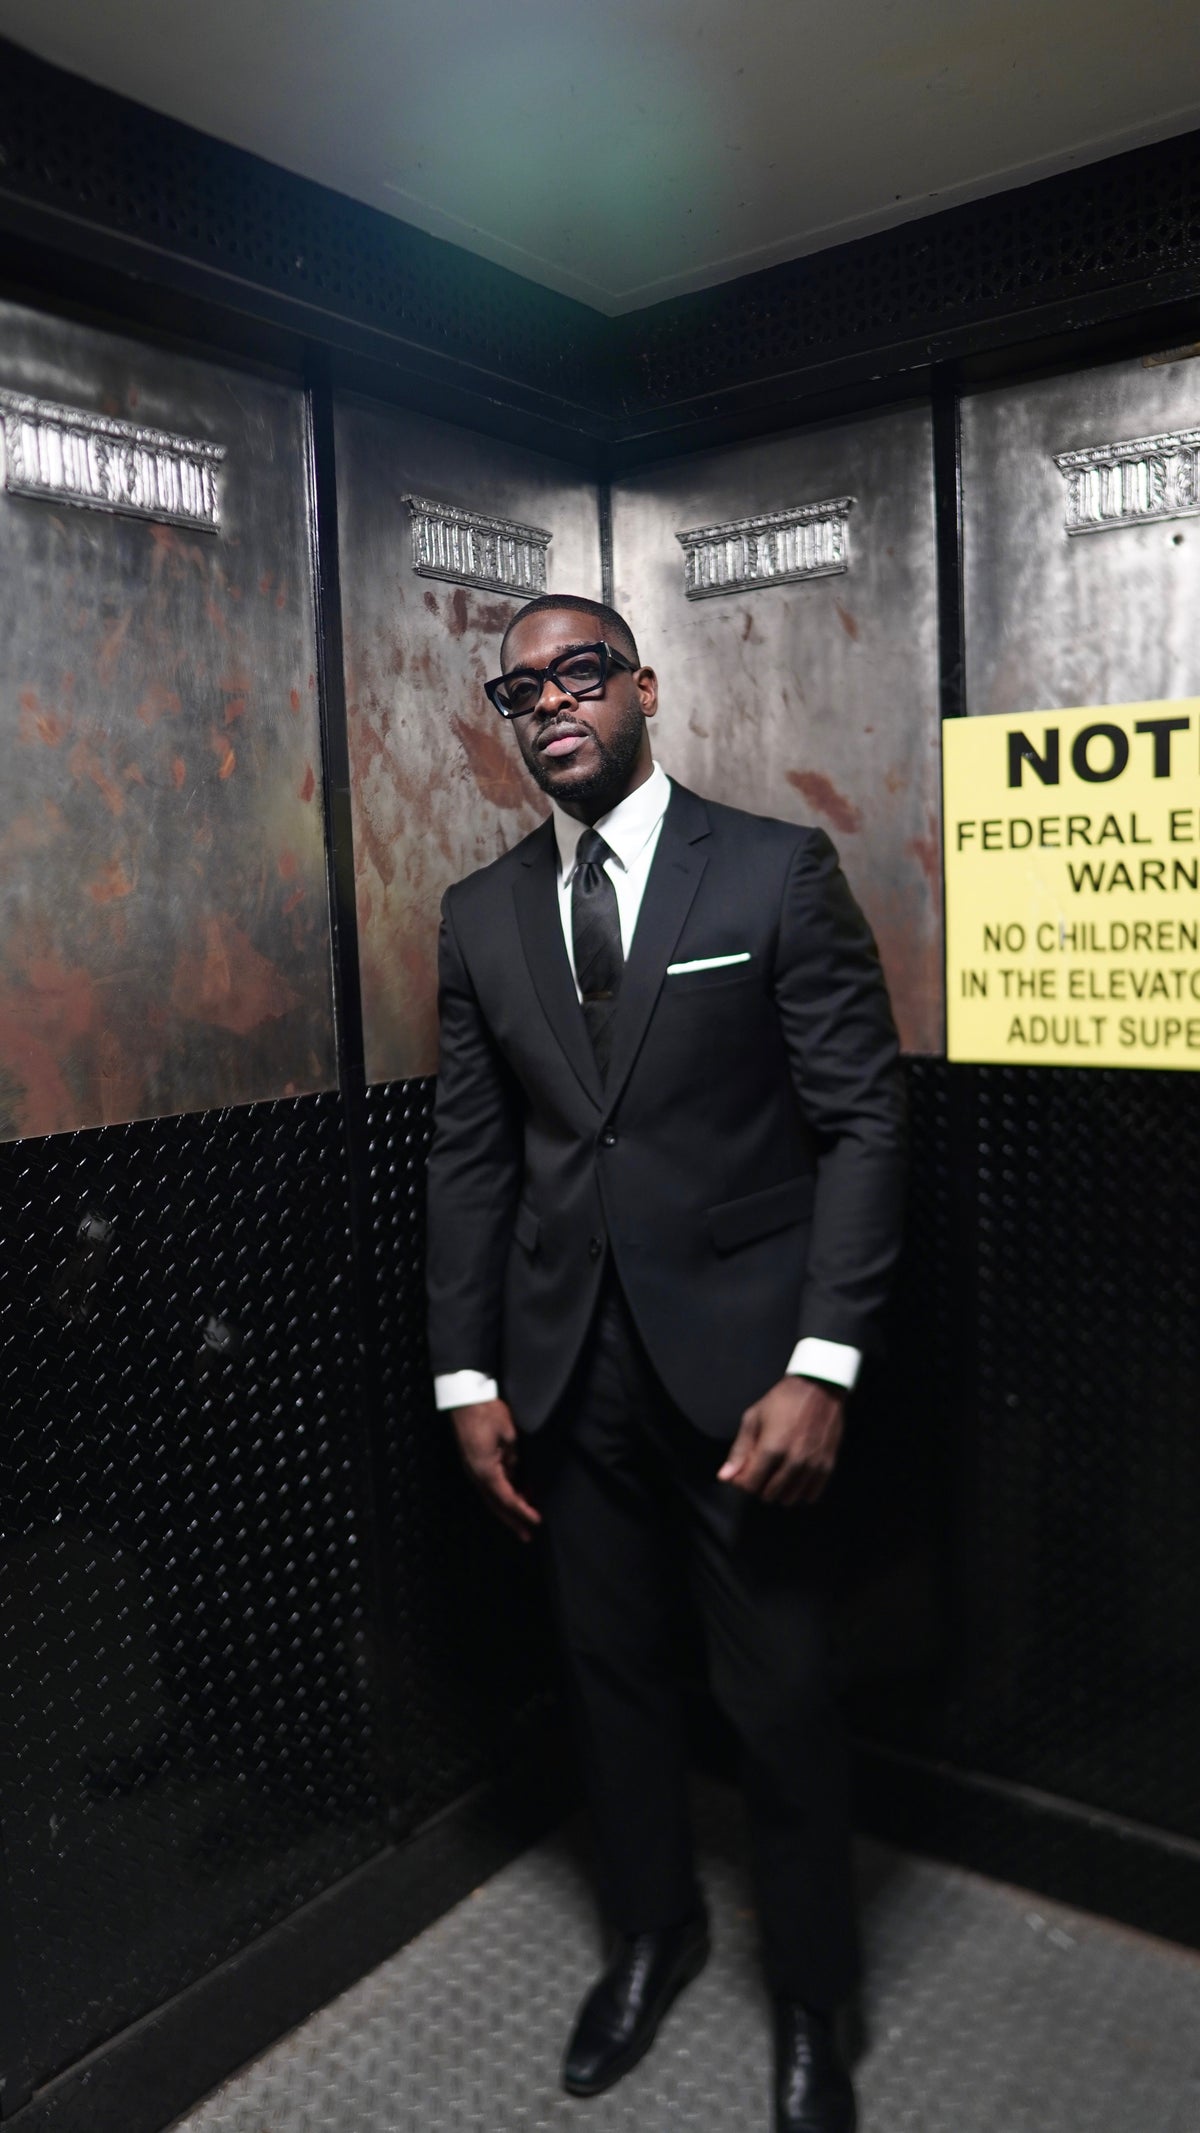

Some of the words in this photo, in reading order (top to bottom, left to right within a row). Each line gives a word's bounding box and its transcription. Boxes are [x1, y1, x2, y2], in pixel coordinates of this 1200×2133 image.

[1007, 715, 1200, 788] NOT
[957, 812, 1153, 851] FEDERAL
[1169, 808, 1200, 843] E
[1067, 857, 1200, 893] WARN
[983, 923, 1026, 953] NO
[1036, 921, 1199, 953] CHILDREN
[961, 970, 988, 998] IN
[1000, 969, 1056, 999] THE
[1007, 1015, 1108, 1046] ADULT
[1118, 1016, 1200, 1049] SUPE
